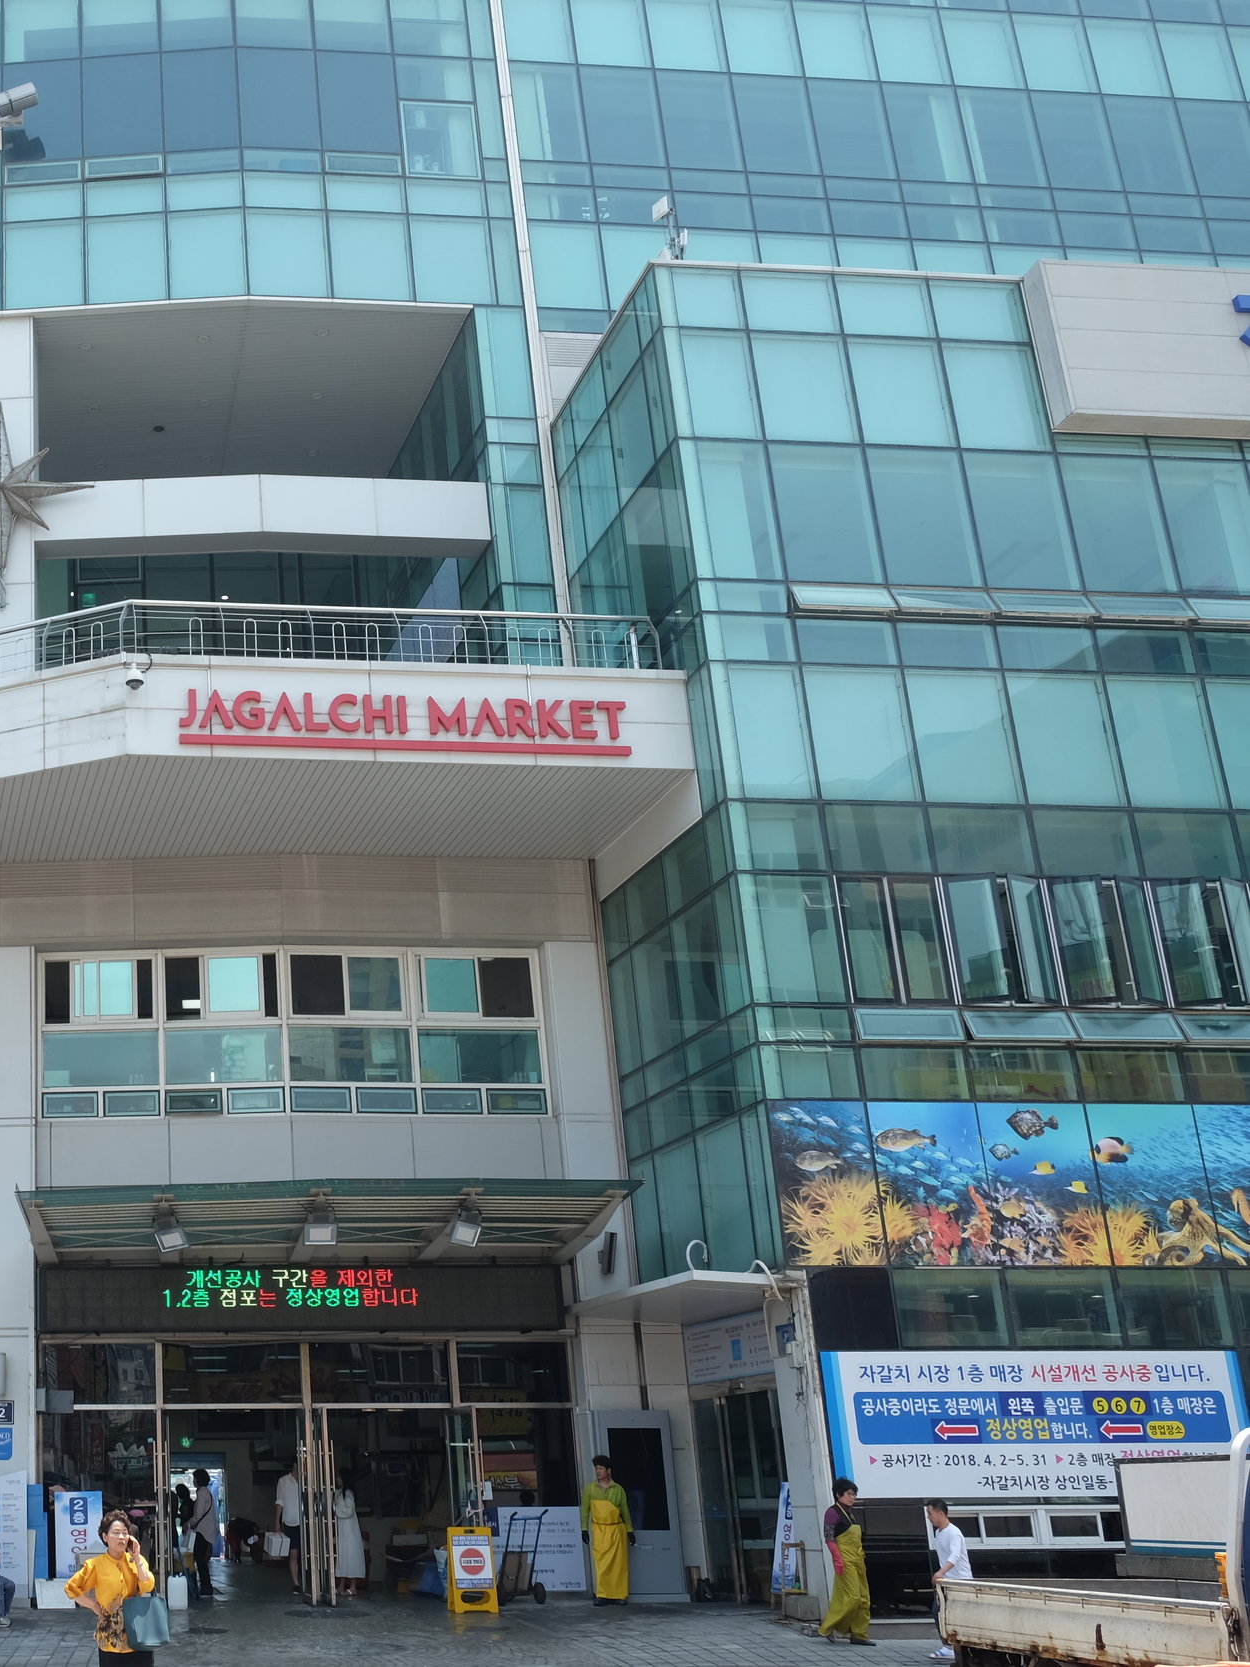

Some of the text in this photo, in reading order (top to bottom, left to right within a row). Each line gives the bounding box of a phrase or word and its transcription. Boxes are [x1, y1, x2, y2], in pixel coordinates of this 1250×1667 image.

[179, 688, 627, 741] JAGALCHI MARKET
[186, 1269, 393, 1288] 개선공사 구간을 제외한
[220, 1289, 277, 1307] 점포는
[286, 1289, 418, 1307] 정상영업합니다
[859, 1364, 1211, 1383] 자갈치 시장 1층 매장 시설개선 공사중입니다.
[861, 1398, 941, 1416] 공사중이라도
[945, 1398, 998, 1416] 정문에서
[1008, 1398, 1035, 1415] 왼쪽
[1043, 1397, 1083, 1415] 출입문
[1153, 1397, 1174, 1415] 1층
[1177, 1397, 1217, 1415] 매장은
[985, 1418, 1092, 1440] 정상영업합니다.
[1149, 1424, 1184, 1436] 영업장소
[882, 1454, 932, 1467] 공사기간
[944, 1455, 980, 1467] 2018.
[984, 1455, 996, 1467] 4.
[1033, 1455, 1047, 1466] 31
[1068, 1453, 1088, 1466] 2층
[1092, 1453, 1116, 1467] 매장
